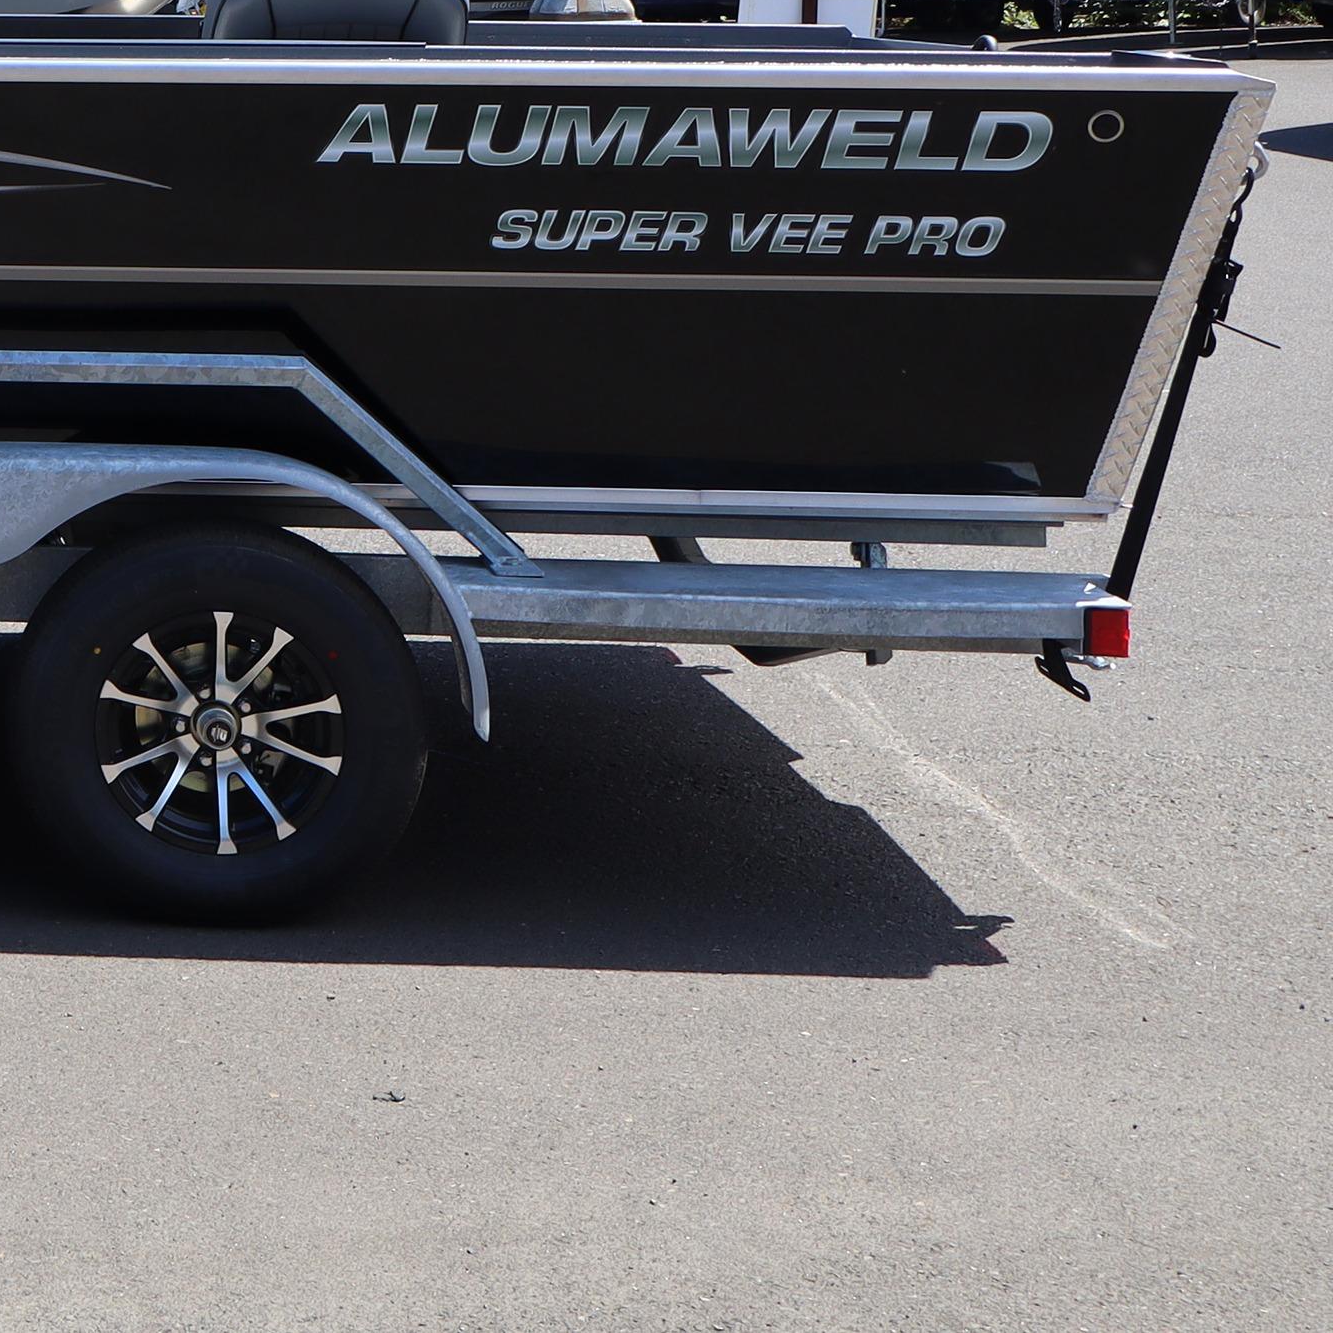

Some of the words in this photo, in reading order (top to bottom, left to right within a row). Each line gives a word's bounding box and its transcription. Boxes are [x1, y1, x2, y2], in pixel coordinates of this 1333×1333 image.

[316, 103, 1054, 172] ALUMAWELD
[491, 208, 709, 253] SUPER
[729, 212, 852, 255] VEE
[864, 215, 1006, 258] PRO
